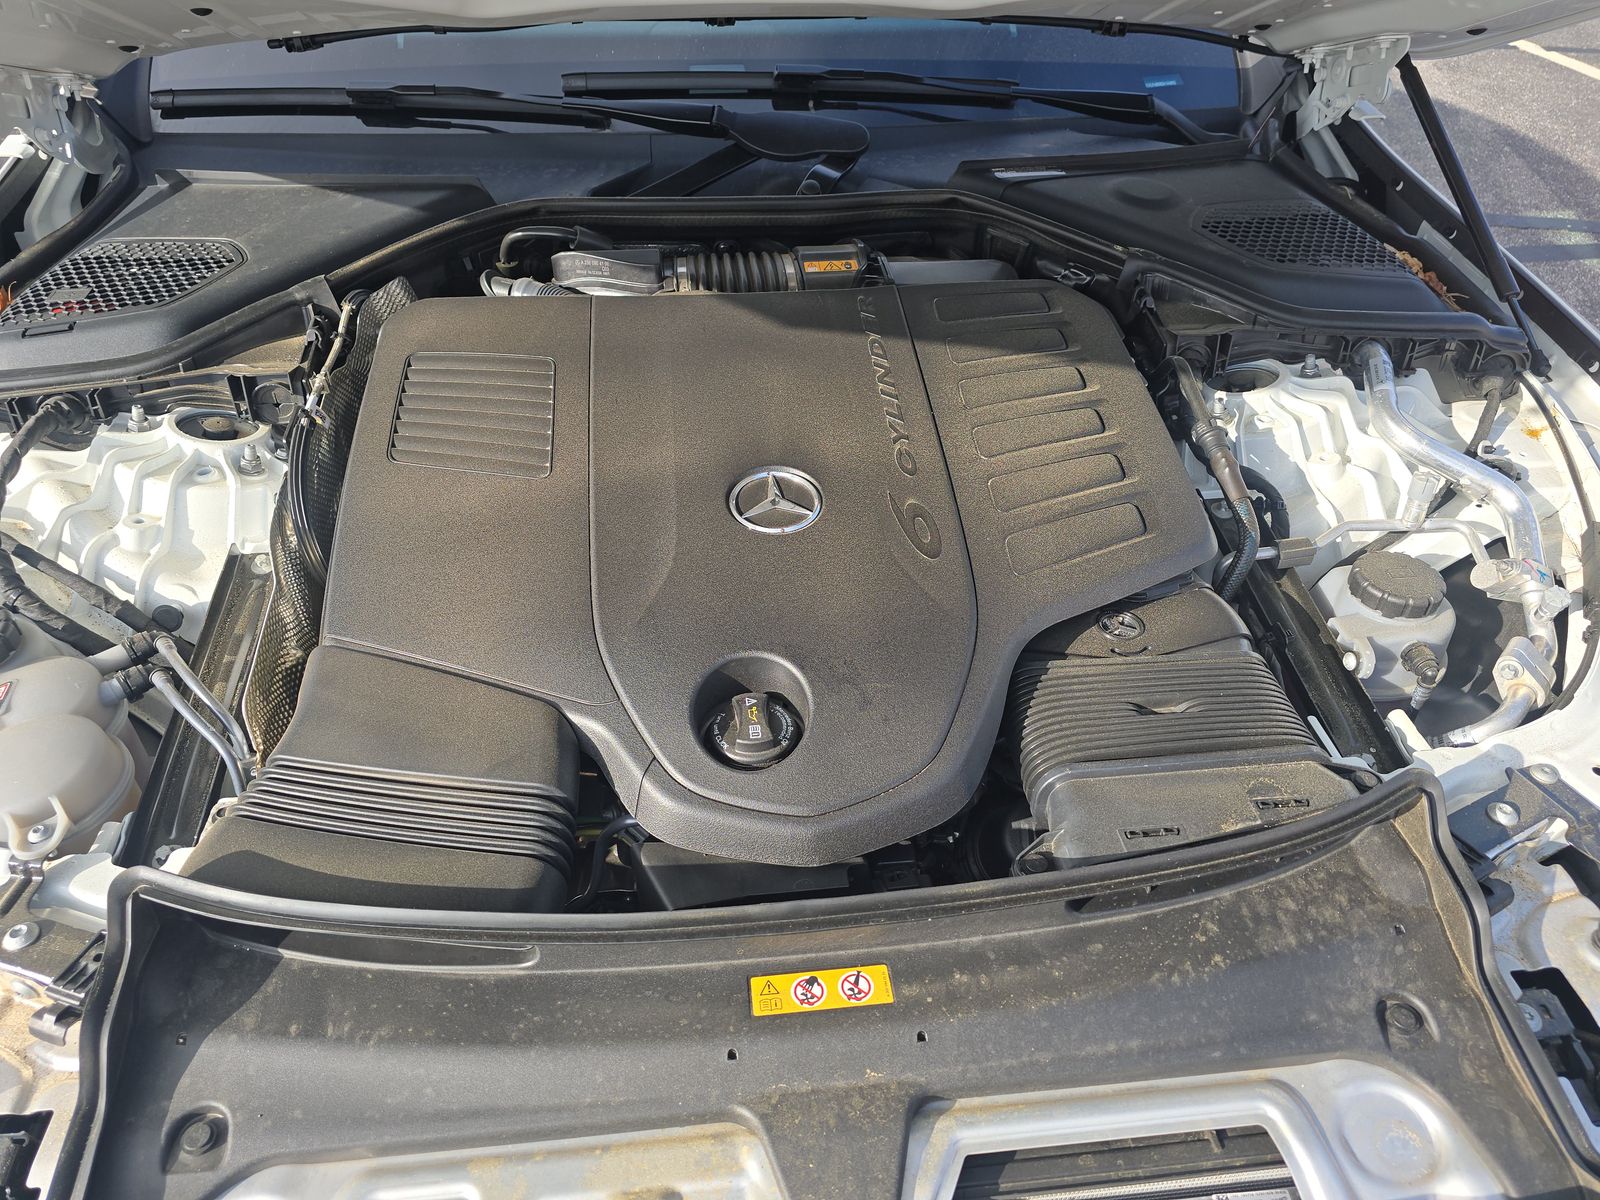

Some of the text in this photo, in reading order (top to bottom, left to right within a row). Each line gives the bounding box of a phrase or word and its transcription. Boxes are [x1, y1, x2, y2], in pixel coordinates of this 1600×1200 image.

[857, 295, 942, 560] 6 CYLINDER
[715, 735, 730, 750] CLICK
